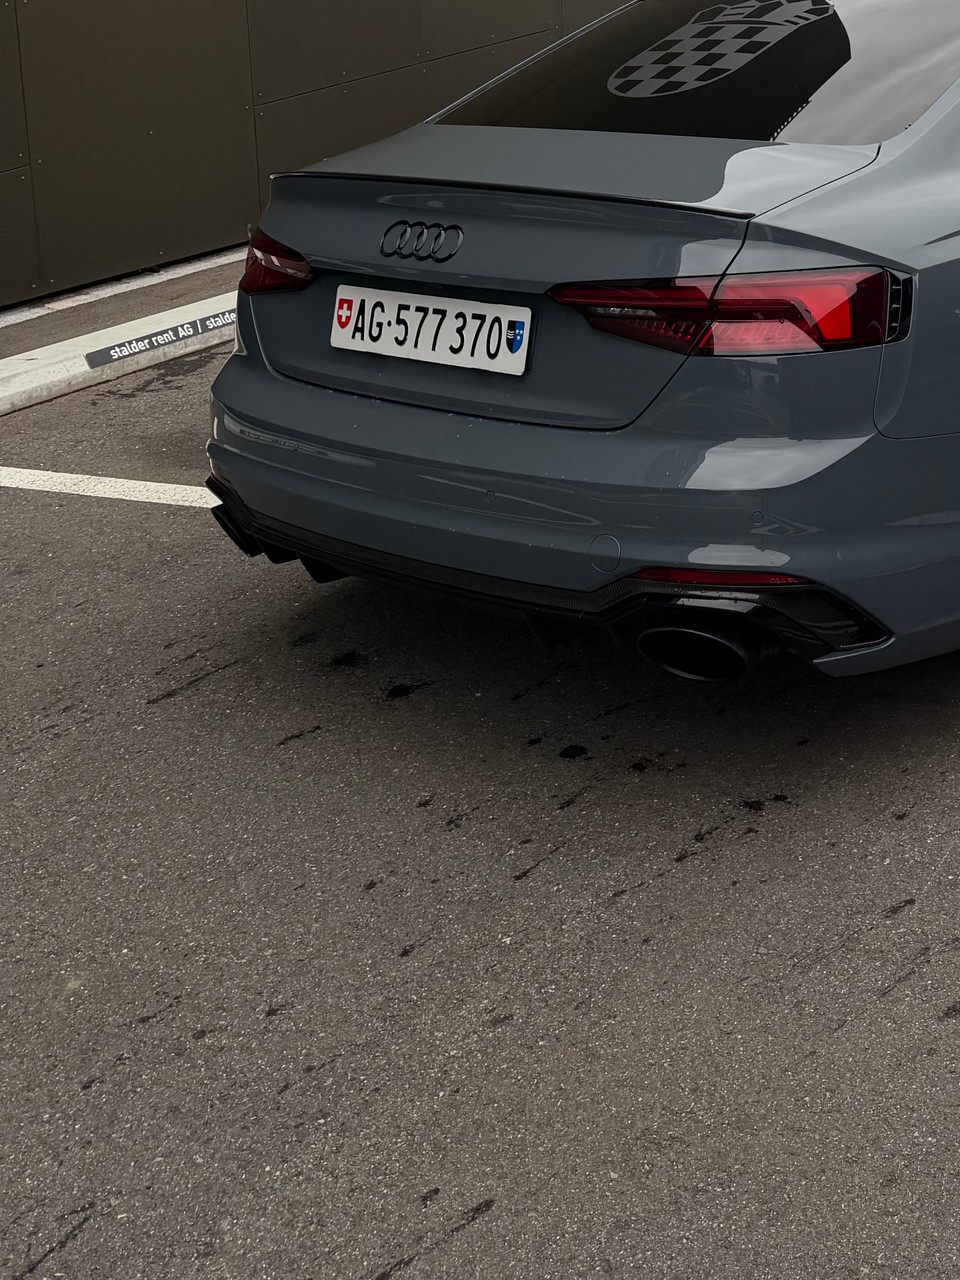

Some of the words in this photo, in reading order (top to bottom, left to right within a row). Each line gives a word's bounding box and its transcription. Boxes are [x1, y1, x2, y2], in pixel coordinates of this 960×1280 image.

[109, 337, 150, 360] stalder
[151, 331, 177, 347] rent
[177, 323, 194, 338] AG
